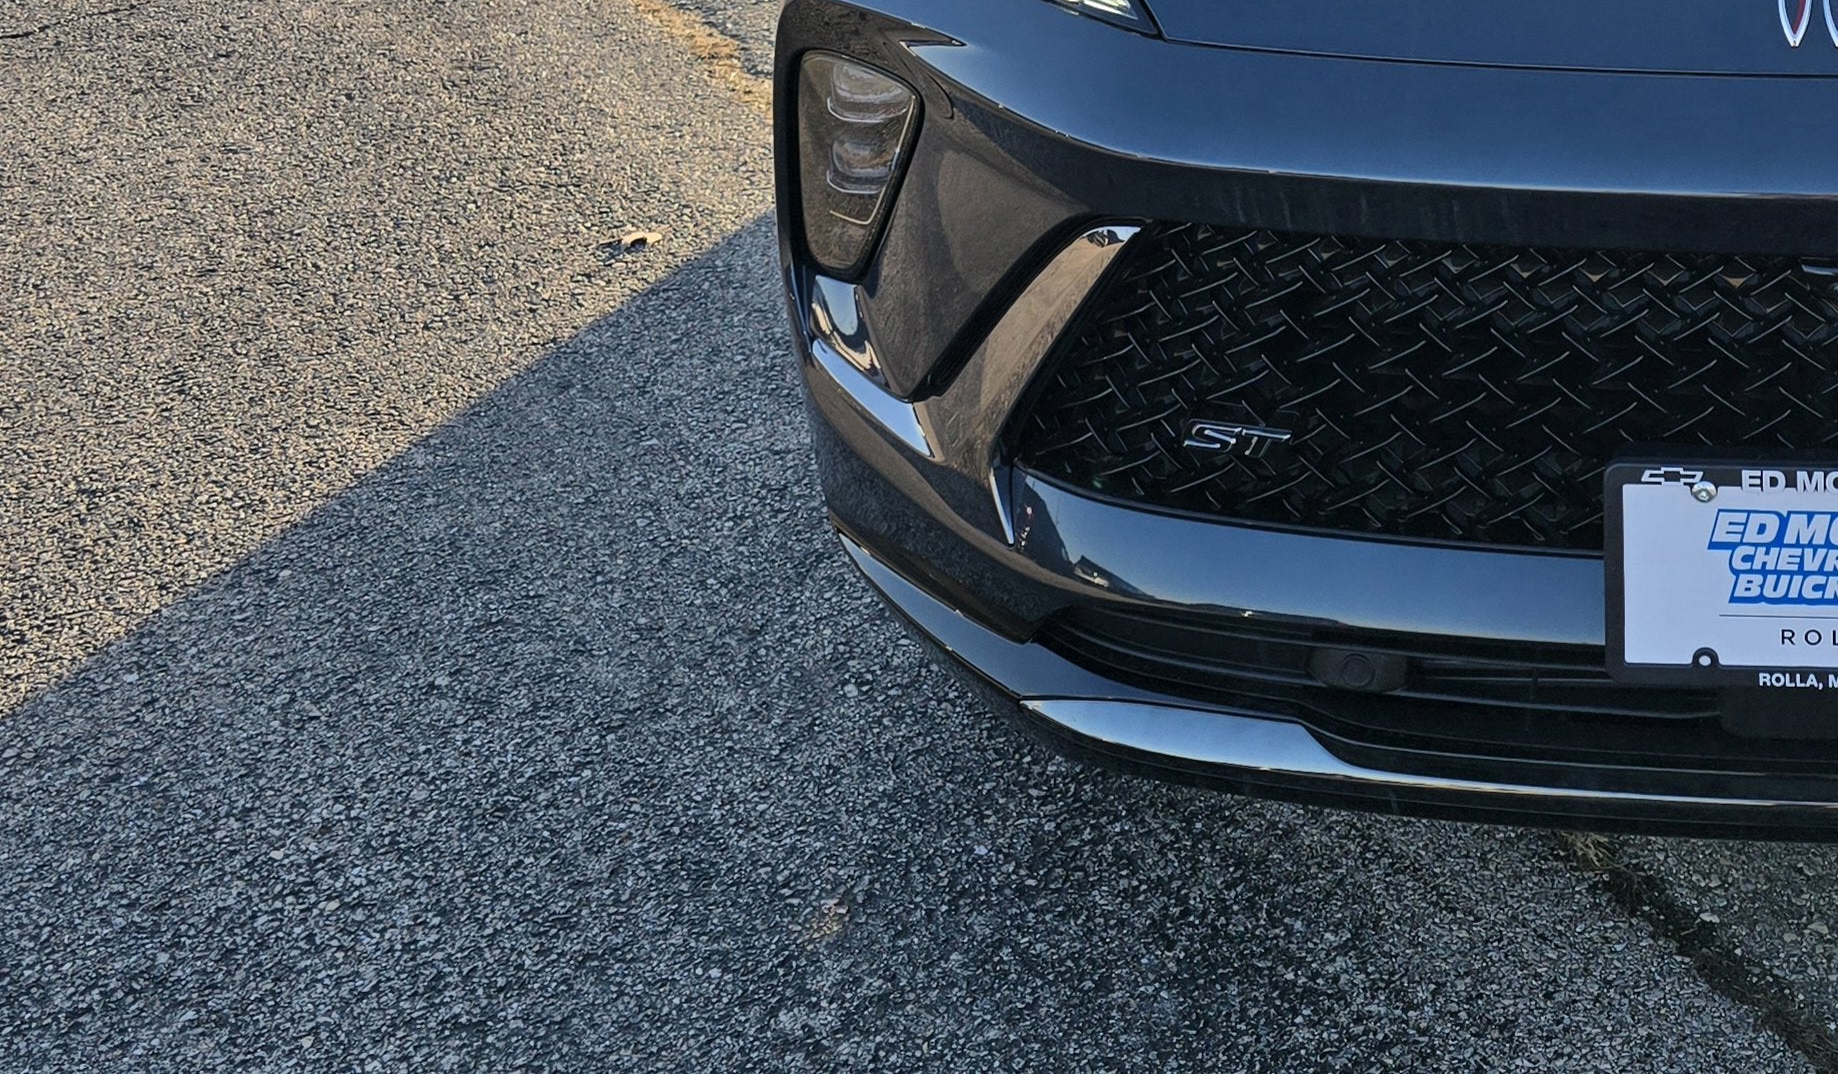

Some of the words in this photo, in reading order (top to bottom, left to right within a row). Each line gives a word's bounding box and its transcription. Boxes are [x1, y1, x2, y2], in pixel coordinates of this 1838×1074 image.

[1183, 419, 1292, 459] ST
[1741, 469, 1787, 494] ED
[1711, 512, 1780, 544] ED
[1758, 673, 1823, 690] ROLLA,
